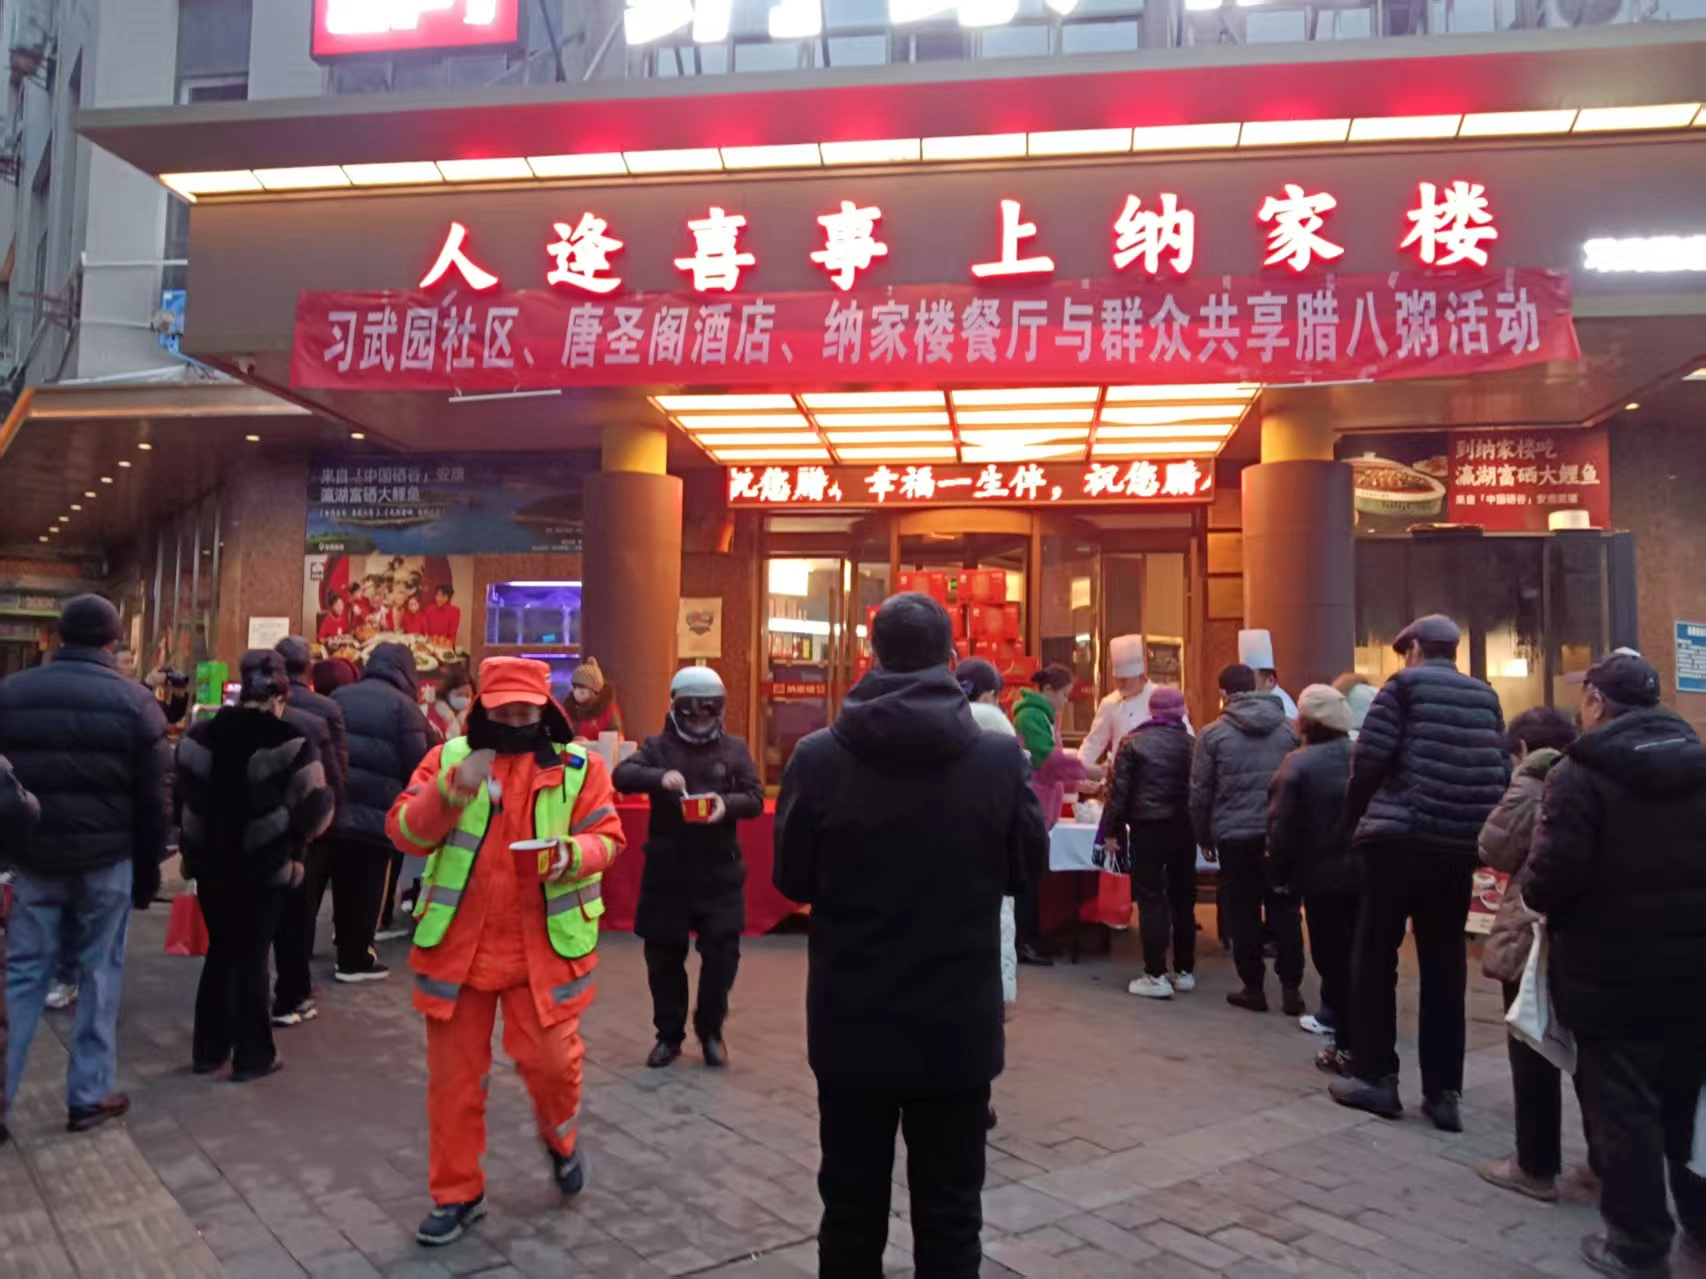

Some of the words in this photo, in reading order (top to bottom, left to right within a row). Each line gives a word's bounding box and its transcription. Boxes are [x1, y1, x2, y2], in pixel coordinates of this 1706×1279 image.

[419, 181, 1498, 294] 人逢喜事上纳家楼
[323, 288, 1541, 374] 习武园社区、唐圣阁酒店、纳家楼餐厅与群众共享腊八粥活动
[1455, 438, 1558, 460] 到纳家楼吃
